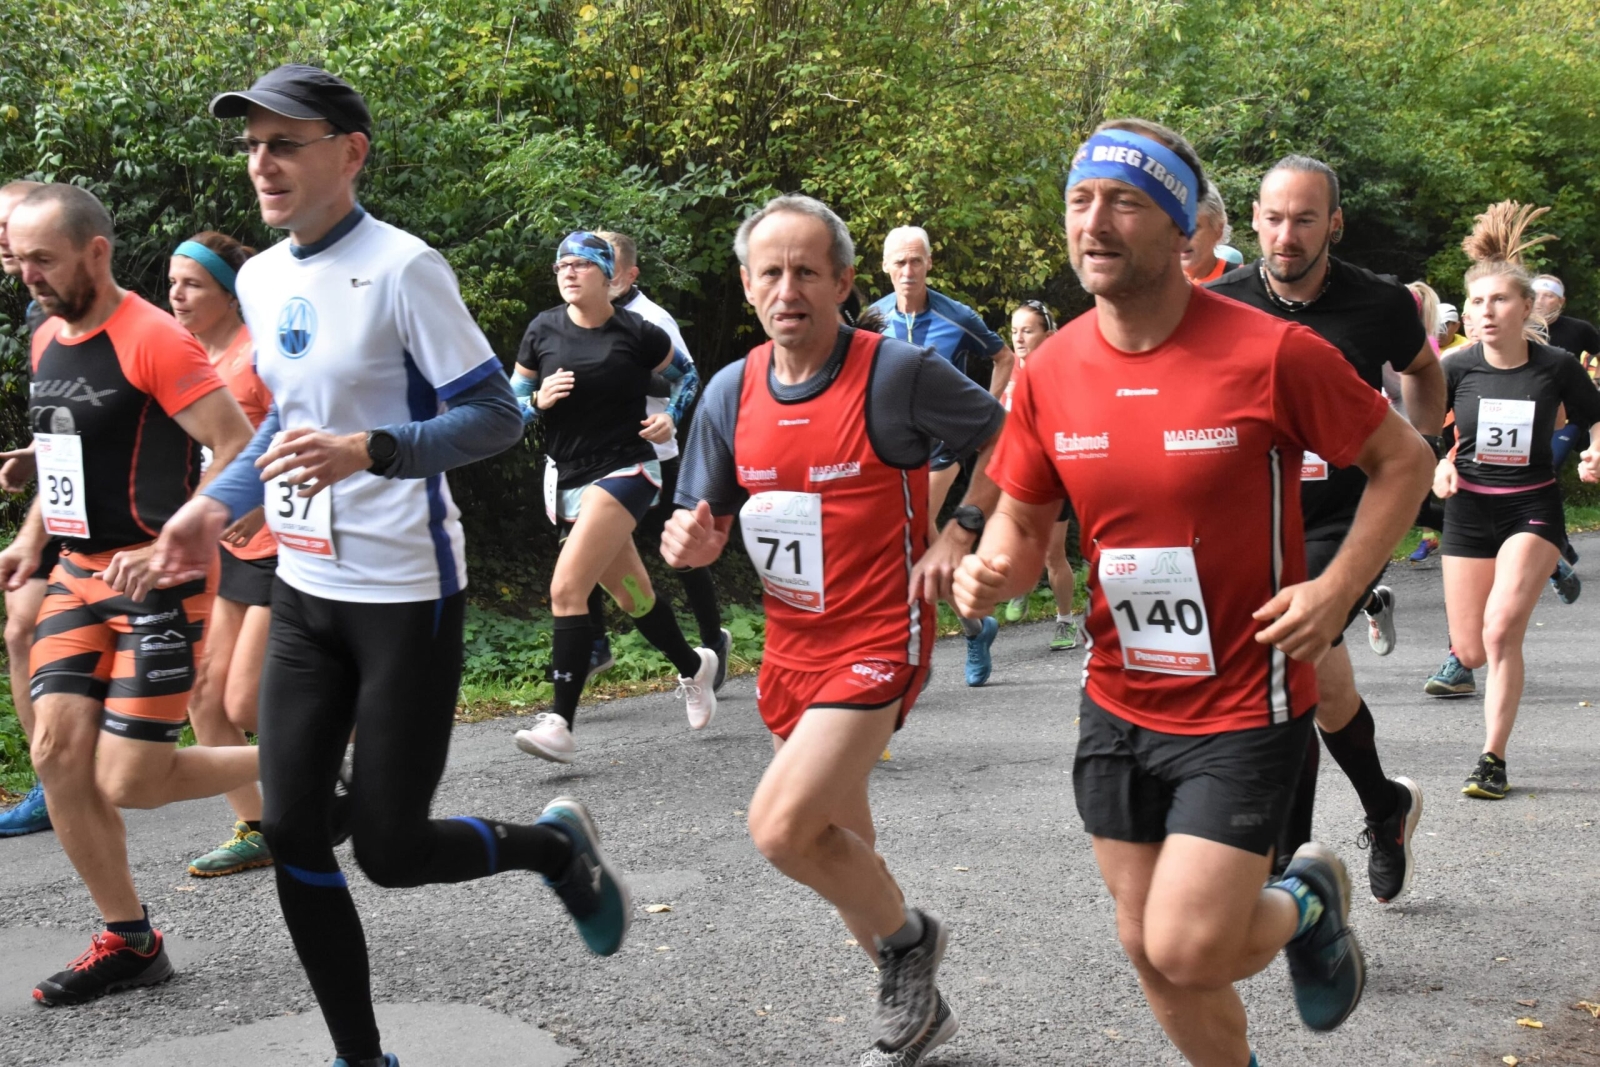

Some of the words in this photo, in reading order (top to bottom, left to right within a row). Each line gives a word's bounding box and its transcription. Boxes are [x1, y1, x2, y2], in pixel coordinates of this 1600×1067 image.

[1092, 145, 1143, 168] BIEG
[1142, 156, 1189, 206] ZBÓJA
[1163, 427, 1238, 443] MARATON
[1486, 427, 1518, 448] 31
[809, 461, 860, 476] MARATON
[1301, 466, 1318, 474] CUP
[47, 474, 74, 507] 39
[277, 480, 313, 520] 37
[756, 536, 802, 575] 71
[1105, 563, 1138, 576] CUP
[1114, 598, 1204, 636] 140
[1178, 656, 1201, 665] CUP
